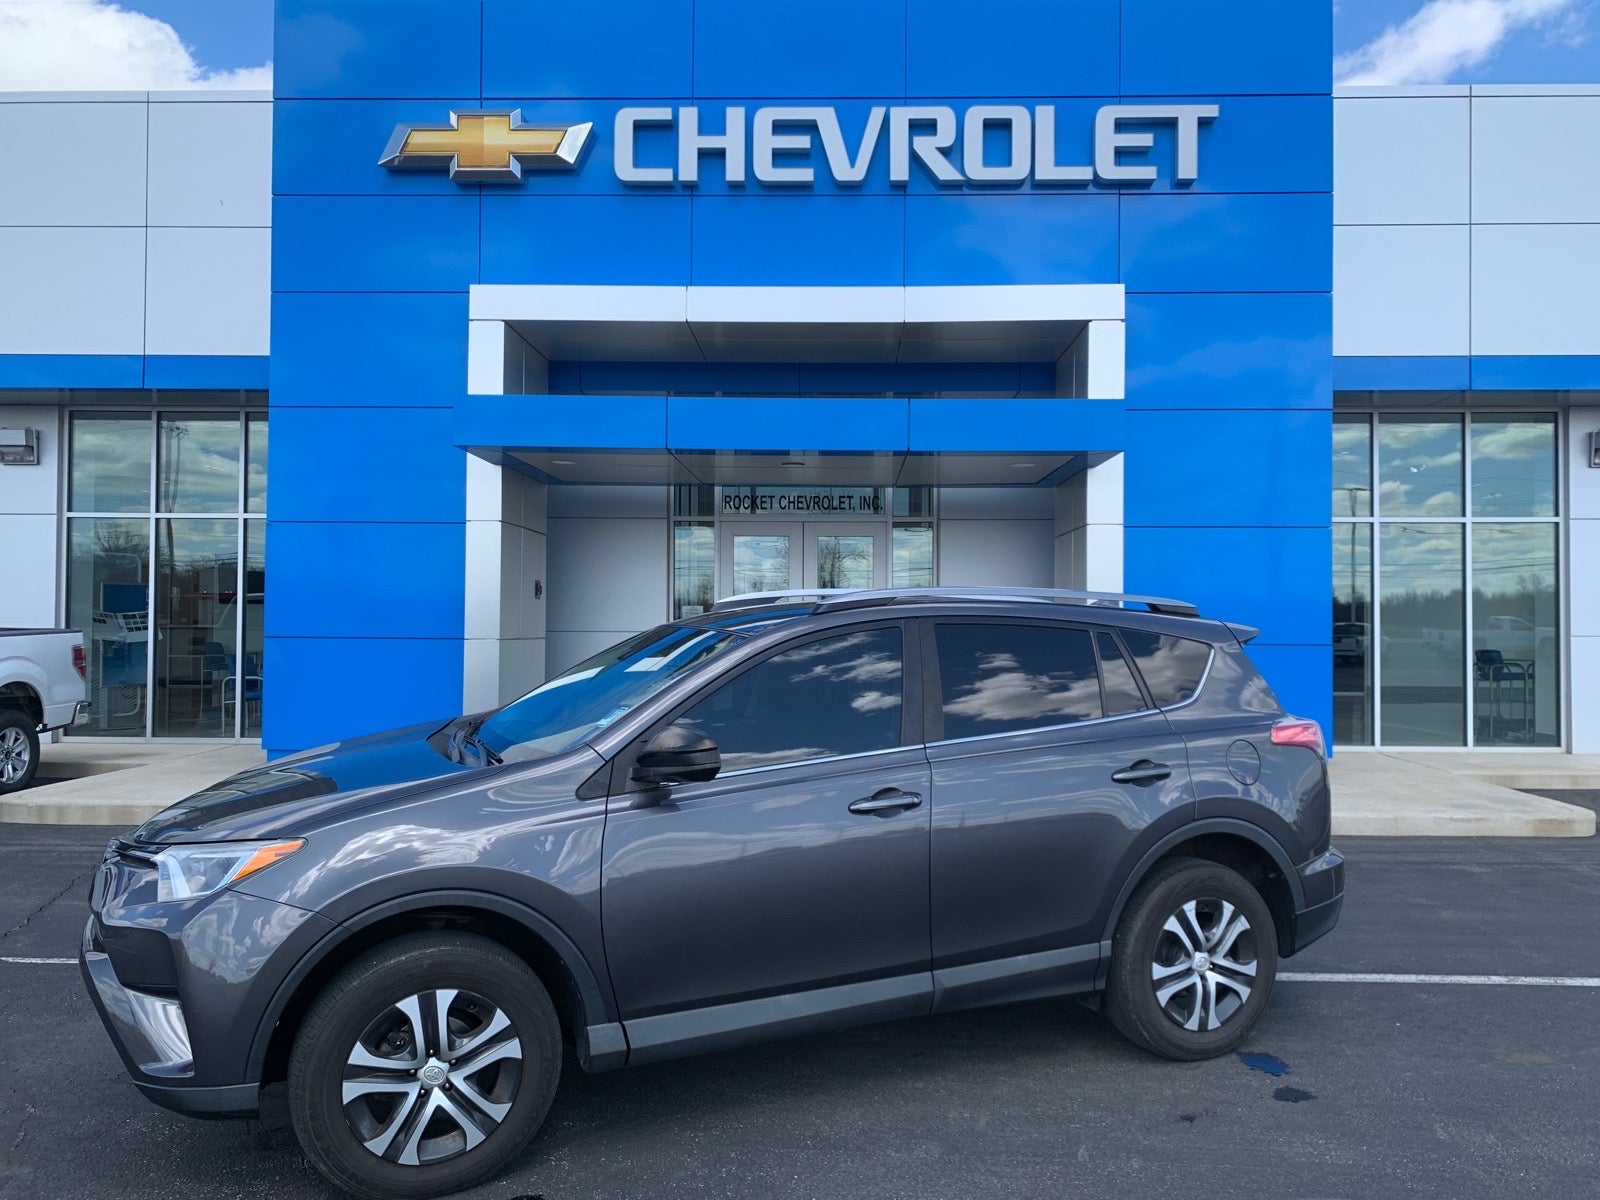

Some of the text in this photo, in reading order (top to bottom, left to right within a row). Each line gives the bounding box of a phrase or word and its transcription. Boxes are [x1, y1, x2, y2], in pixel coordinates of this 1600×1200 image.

[613, 104, 1220, 187] CHEVROLET
[724, 495, 883, 512] ROCKET CHEVROLET, INC.
